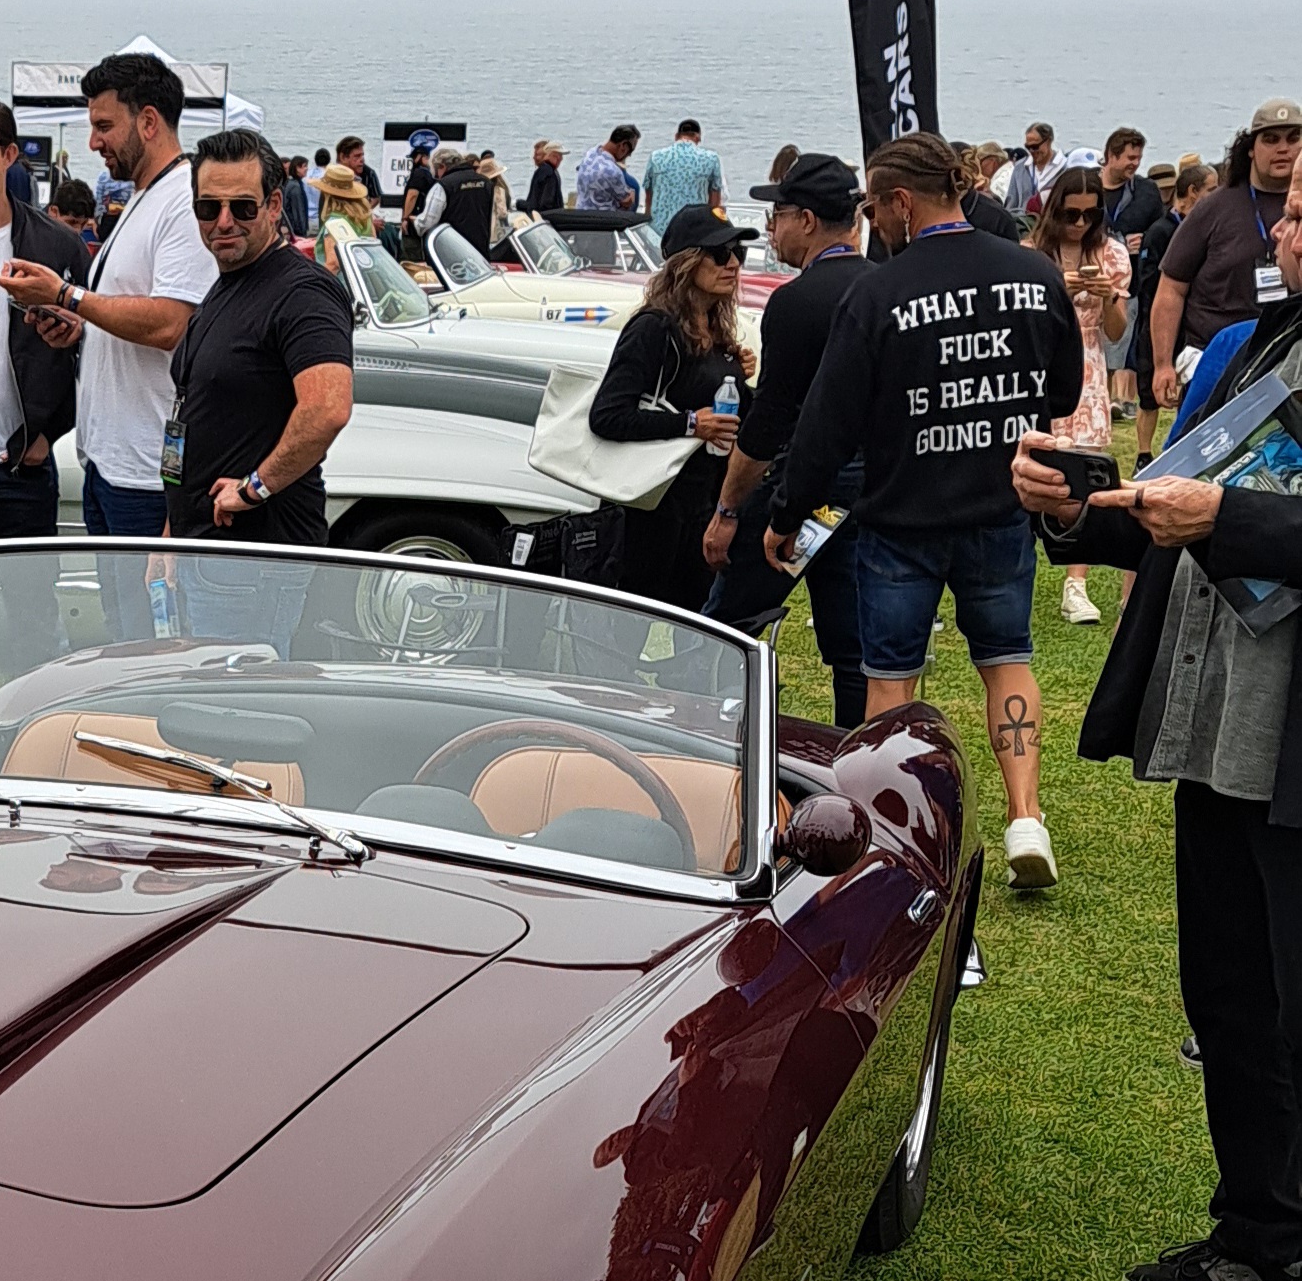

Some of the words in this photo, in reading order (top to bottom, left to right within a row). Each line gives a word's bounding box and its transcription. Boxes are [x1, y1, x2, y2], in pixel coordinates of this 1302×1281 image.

[58, 74, 81, 84] RANC
[895, 0, 920, 138] CARS
[891, 287, 977, 331] WHAT
[991, 282, 1047, 312] THE
[939, 328, 1012, 365] FUCK
[906, 387, 929, 417] IS
[940, 369, 1046, 409] REALLY
[916, 420, 992, 456] GOING
[1003, 413, 1039, 444] ON
